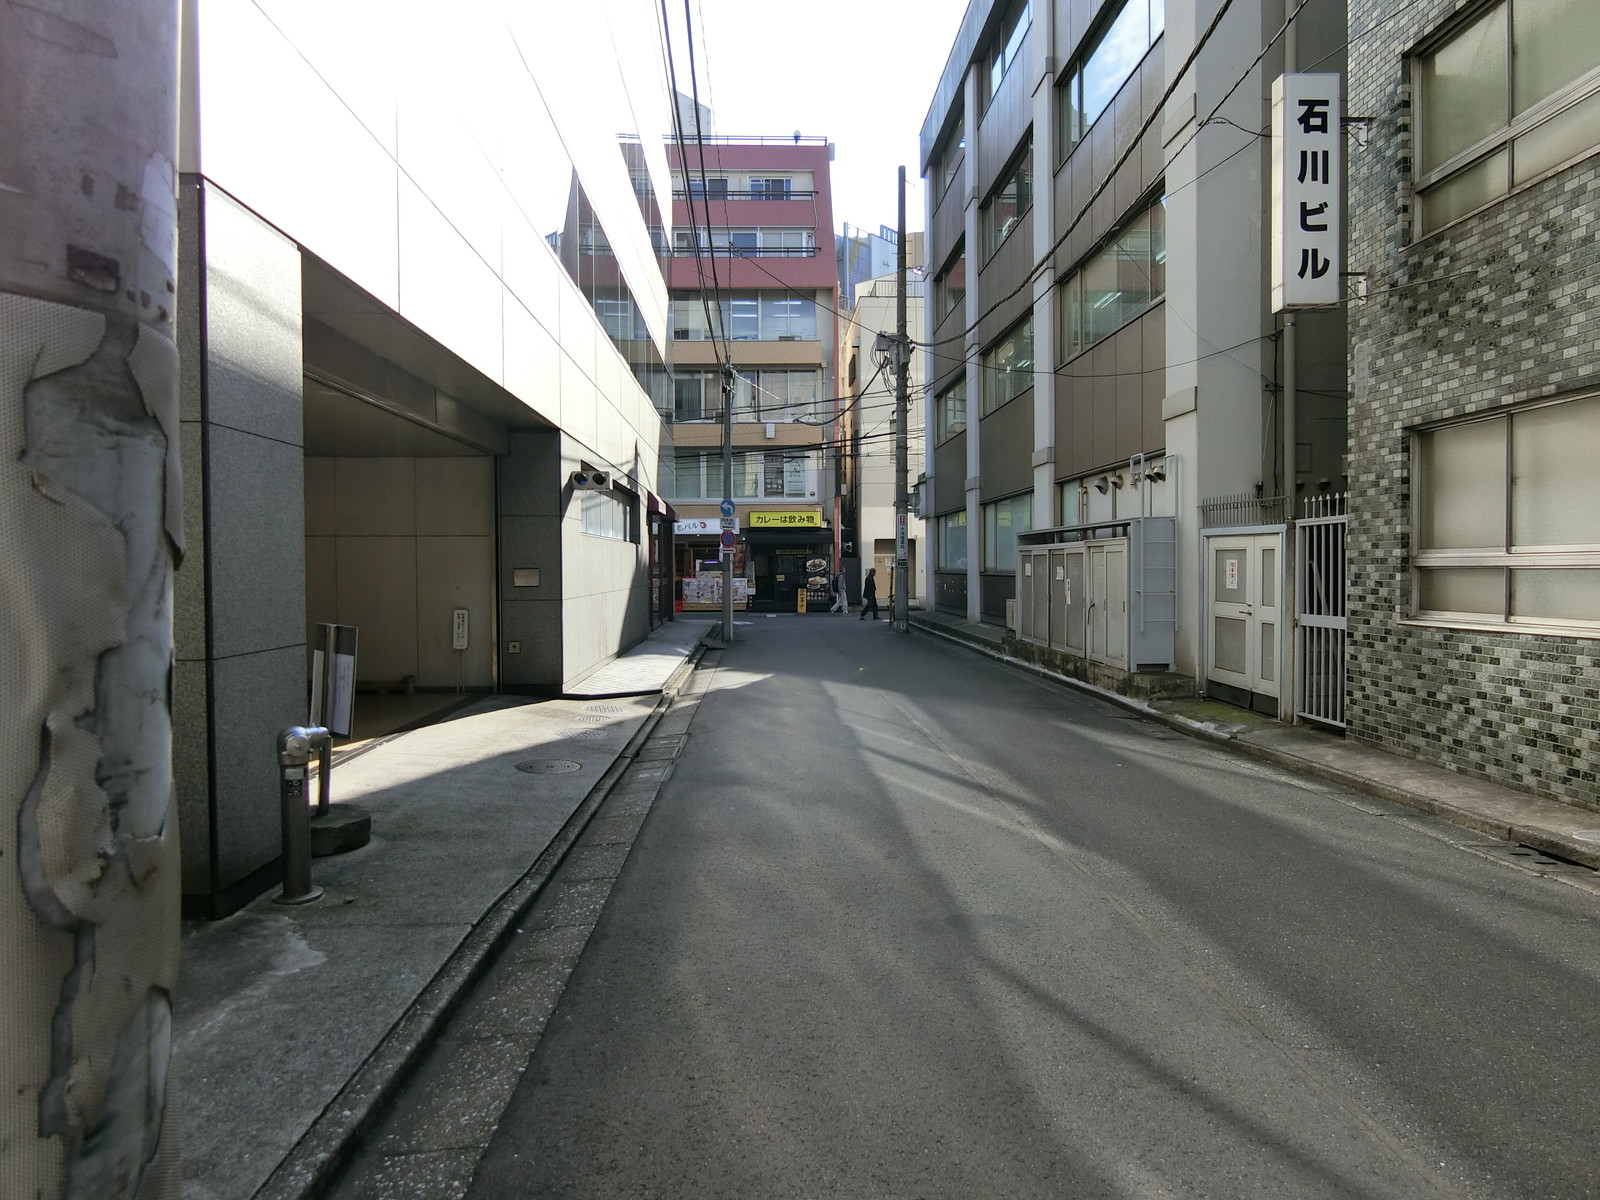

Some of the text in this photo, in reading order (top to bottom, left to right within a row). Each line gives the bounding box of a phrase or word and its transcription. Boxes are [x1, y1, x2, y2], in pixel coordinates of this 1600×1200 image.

[1296, 99, 1331, 280] 石川ビル
[755, 515, 815, 524] カレーは飲み物
